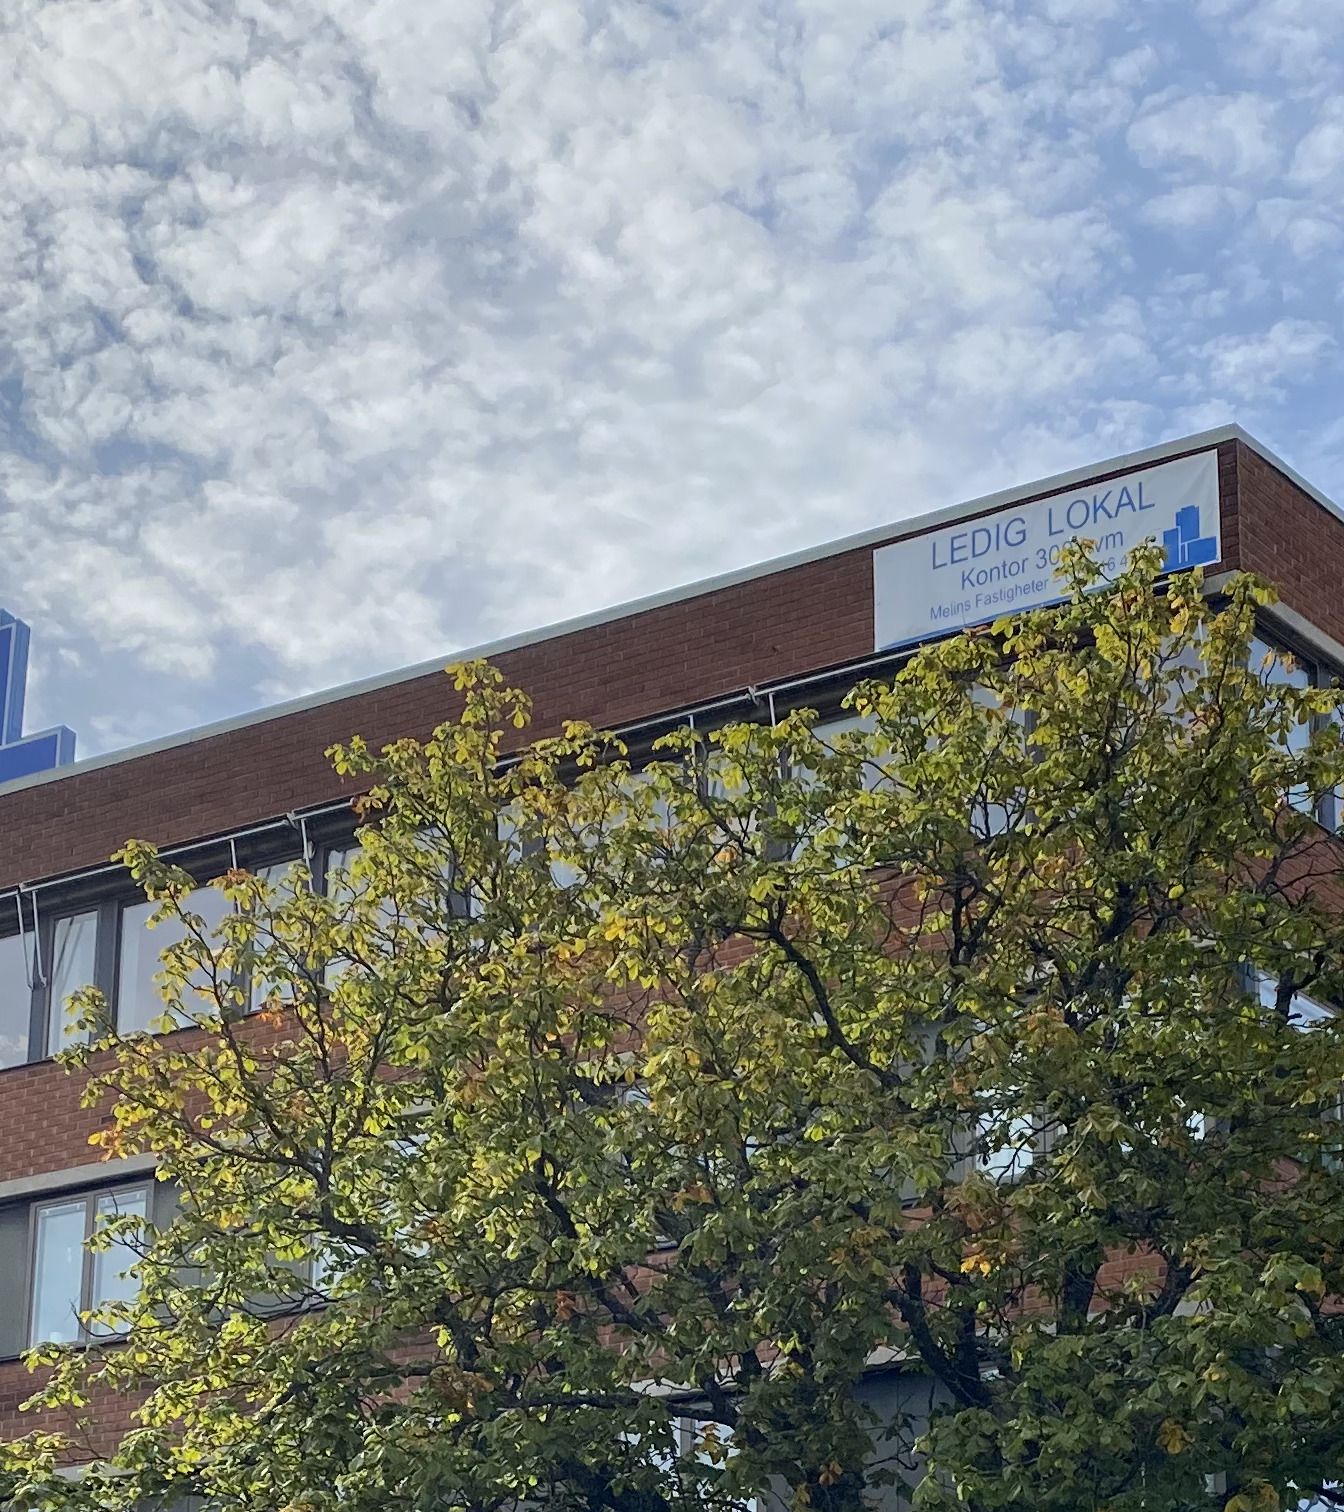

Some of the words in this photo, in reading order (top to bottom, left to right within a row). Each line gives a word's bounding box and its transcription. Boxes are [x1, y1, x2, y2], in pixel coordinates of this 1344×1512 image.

[931, 517, 1027, 570] LEDIG
[1047, 481, 1156, 537] LOKAL
[960, 557, 1029, 591] Kontor
[929, 598, 972, 620] Melins
[974, 579, 1049, 610] Fastigheter
